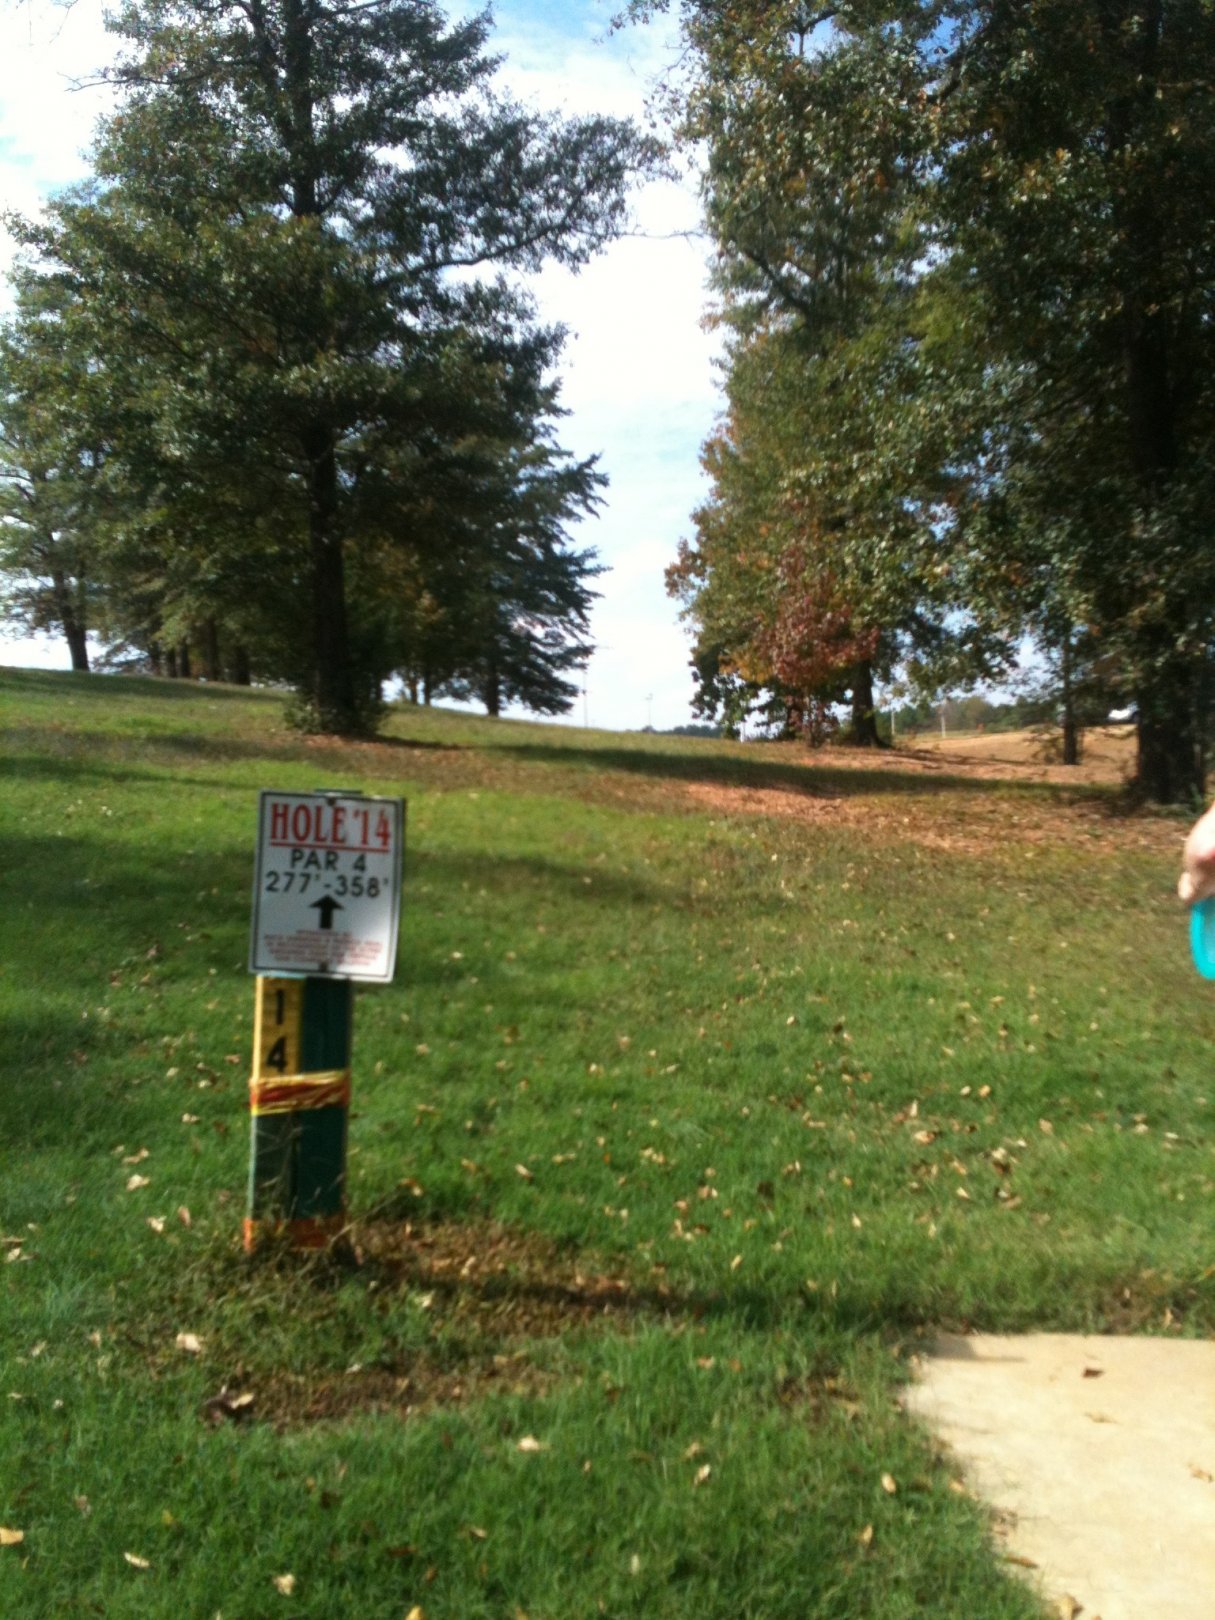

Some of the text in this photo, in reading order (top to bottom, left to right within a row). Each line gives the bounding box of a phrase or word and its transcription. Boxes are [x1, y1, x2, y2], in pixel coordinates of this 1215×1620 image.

[271, 803, 346, 844] HOLE
[290, 849, 366, 872] PAR 4
